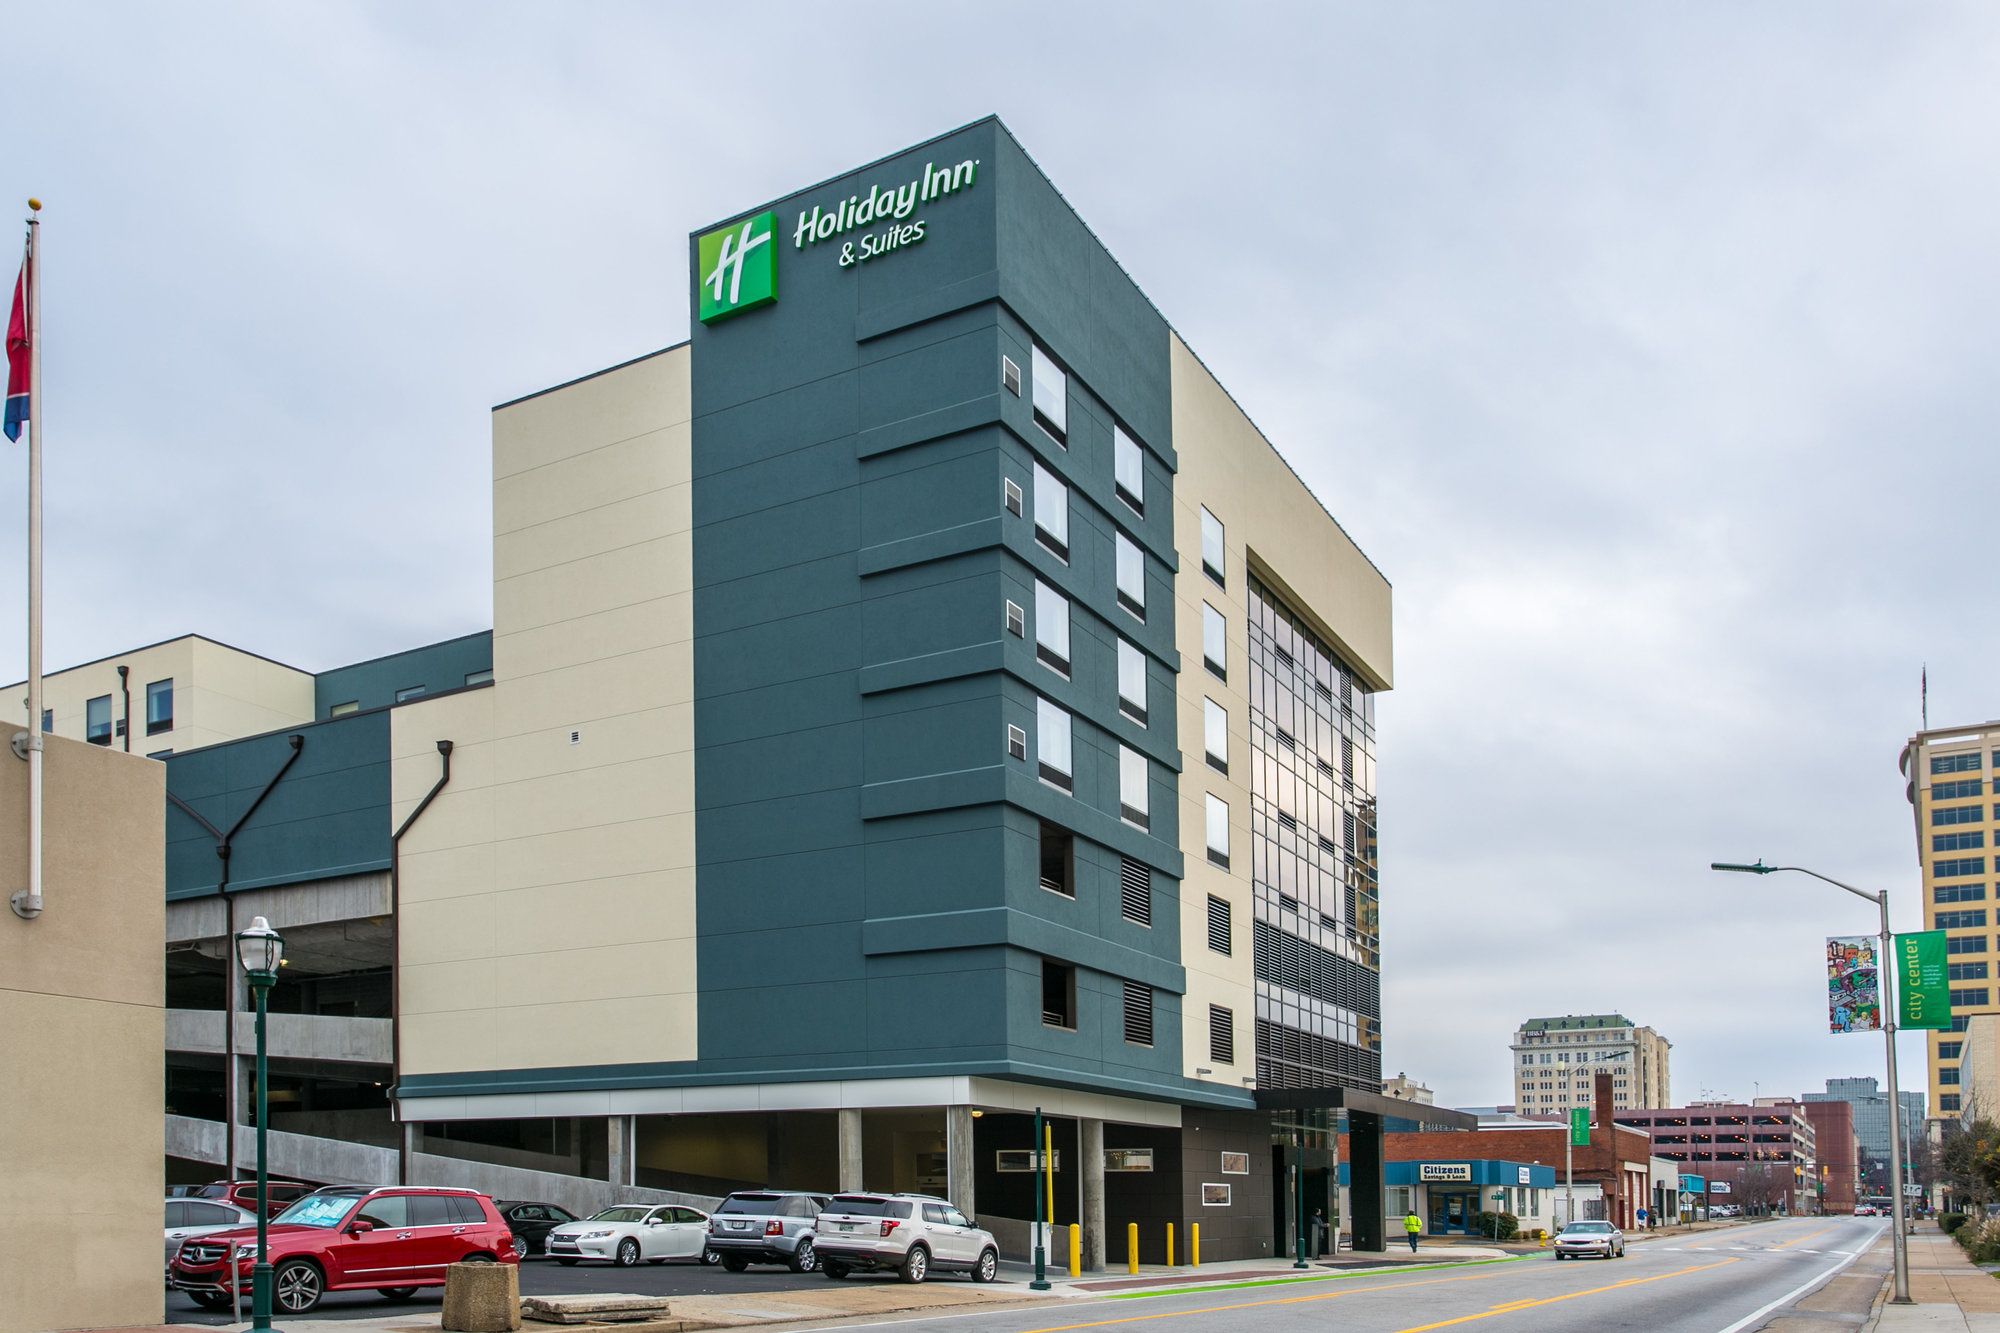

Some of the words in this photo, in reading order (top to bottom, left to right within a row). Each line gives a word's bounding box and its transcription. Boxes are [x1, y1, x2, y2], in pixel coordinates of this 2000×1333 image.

[793, 181, 919, 248] Holiday
[921, 159, 977, 202] Inn
[839, 242, 856, 267] &
[859, 220, 928, 260] Suites
[1906, 938, 1920, 987] center
[1907, 991, 1925, 1020] city
[1424, 1165, 1466, 1174] Citizens
